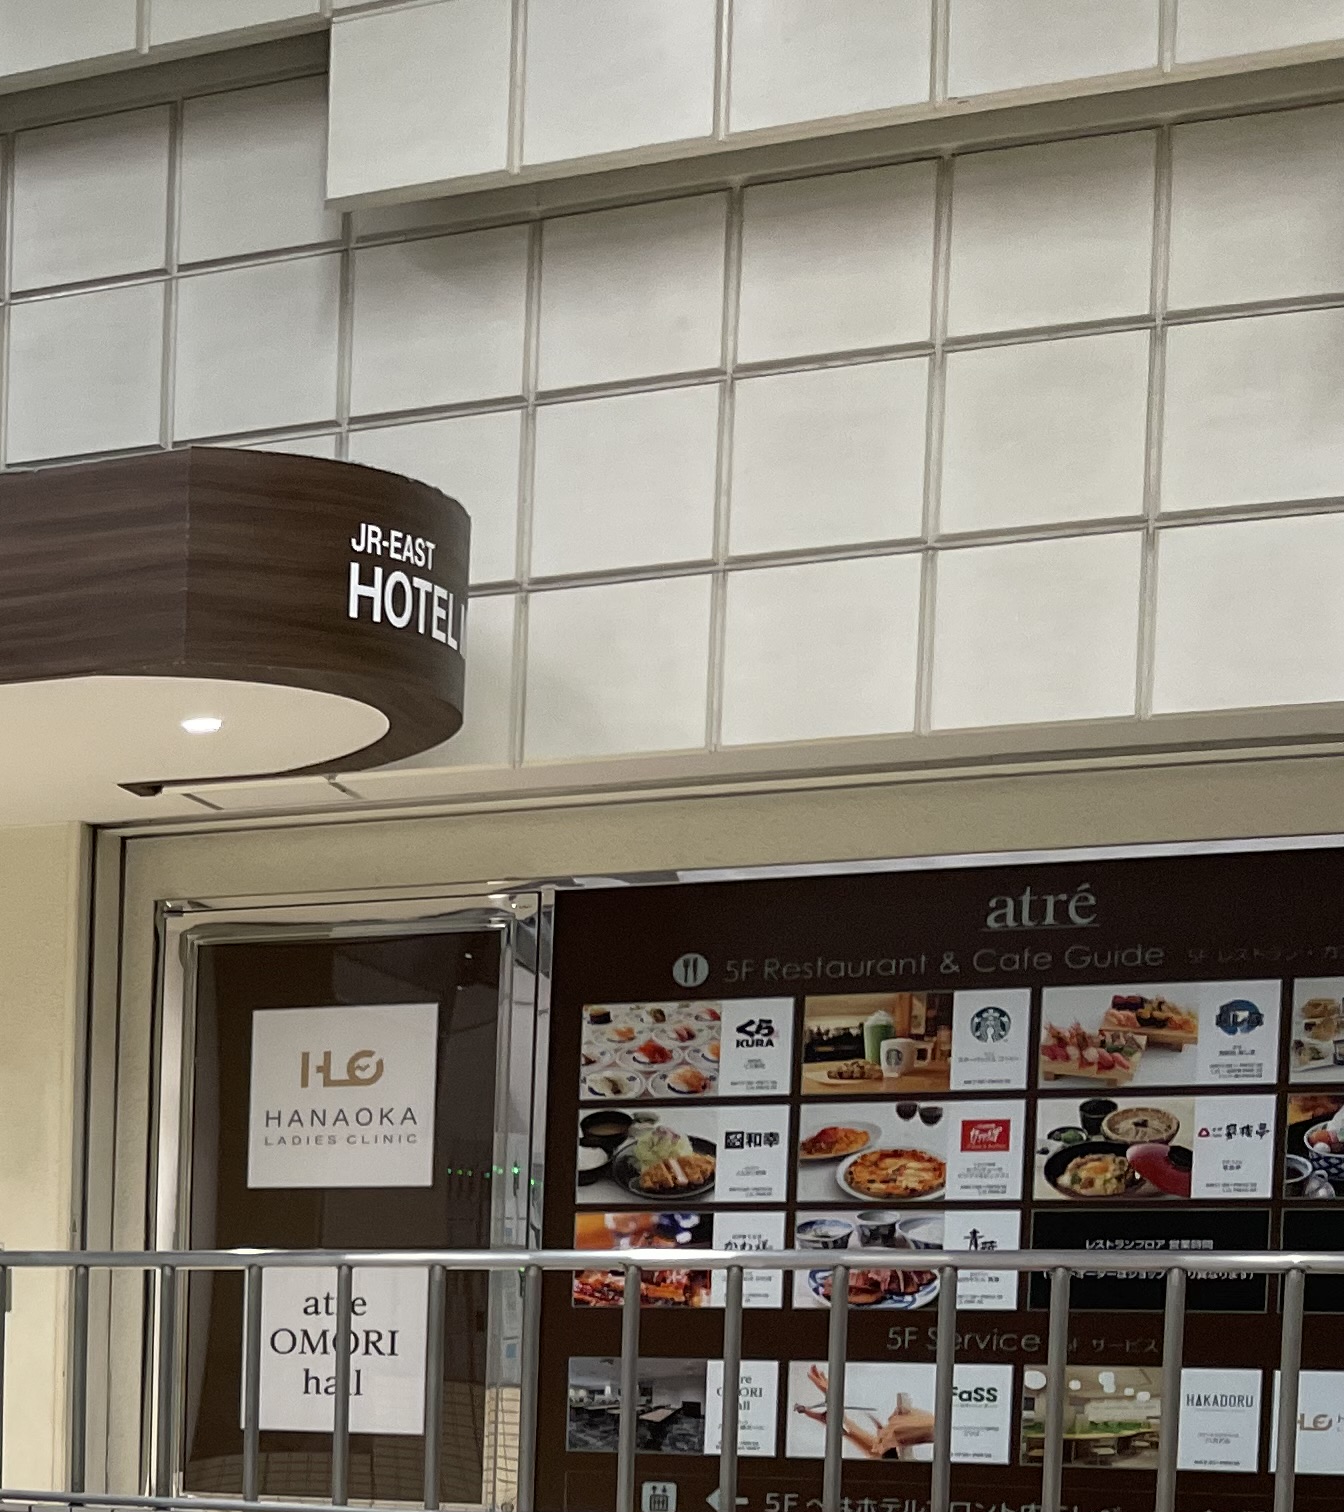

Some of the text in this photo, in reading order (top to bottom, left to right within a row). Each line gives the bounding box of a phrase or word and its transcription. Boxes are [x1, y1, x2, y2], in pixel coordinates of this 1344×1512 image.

[350, 522, 436, 571] JR-EAST
[348, 561, 458, 651] HOTEL
[986, 883, 1098, 928] atré
[724, 960, 754, 983] 5F
[764, 953, 928, 981] Restaurant
[940, 952, 961, 974] &
[1065, 944, 1164, 970] Guide
[736, 1018, 775, 1038] くら
[736, 1039, 775, 1049] KURA
[265, 1107, 418, 1128] HANAOKA
[264, 1133, 417, 1146] LADIES CLINIC
[303, 1291, 367, 1316] ate
[270, 1328, 400, 1356] OMORI
[887, 1327, 918, 1351] 5F
[303, 1368, 363, 1396] hal
[717, 1386, 763, 1398] OORI
[1186, 1393, 1254, 1408] HAKADORU
